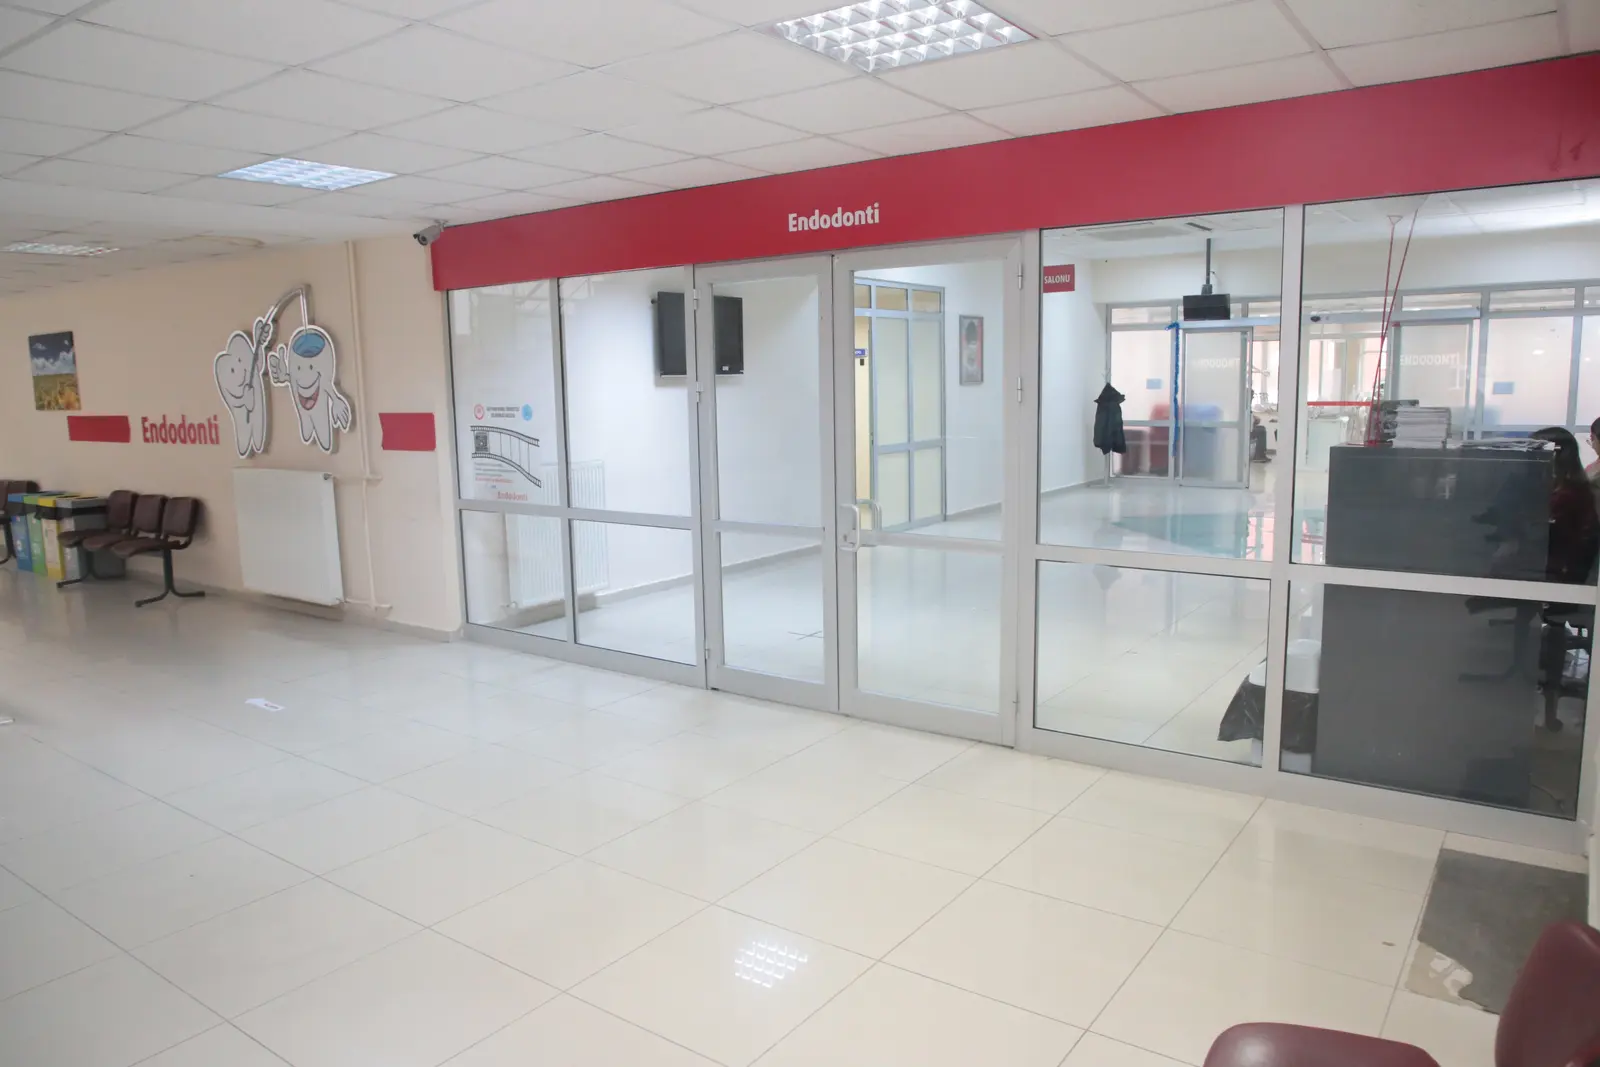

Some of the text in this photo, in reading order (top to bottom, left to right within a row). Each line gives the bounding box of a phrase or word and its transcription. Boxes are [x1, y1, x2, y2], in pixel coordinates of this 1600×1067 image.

[788, 202, 880, 232] Endodonti
[1044, 274, 1071, 284] SALONU
[141, 414, 220, 445] Endodonti
